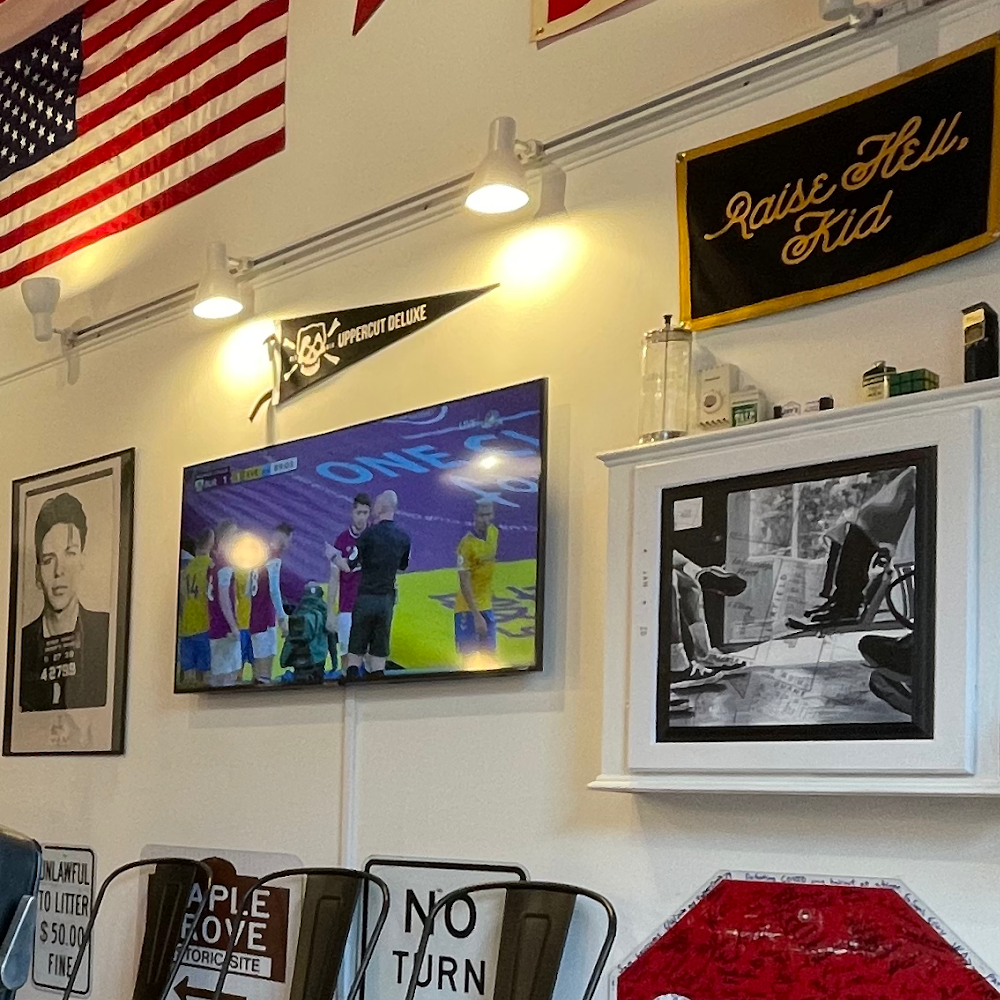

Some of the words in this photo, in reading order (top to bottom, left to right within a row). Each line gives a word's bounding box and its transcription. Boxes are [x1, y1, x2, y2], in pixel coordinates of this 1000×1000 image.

[703, 172, 838, 240] Raise
[781, 189, 894, 265] Kid
[338, 317, 387, 349] UPPERCUT
[388, 303, 428, 332] DELUXE
[316, 444, 470, 485] ONE
[38, 889, 51, 912] TO
[55, 891, 89, 917] LITTER
[404, 888, 477, 939] NO
[48, 952, 74, 978] FINE
[229, 954, 261, 973] SITE
[392, 950, 486, 996] TURN
